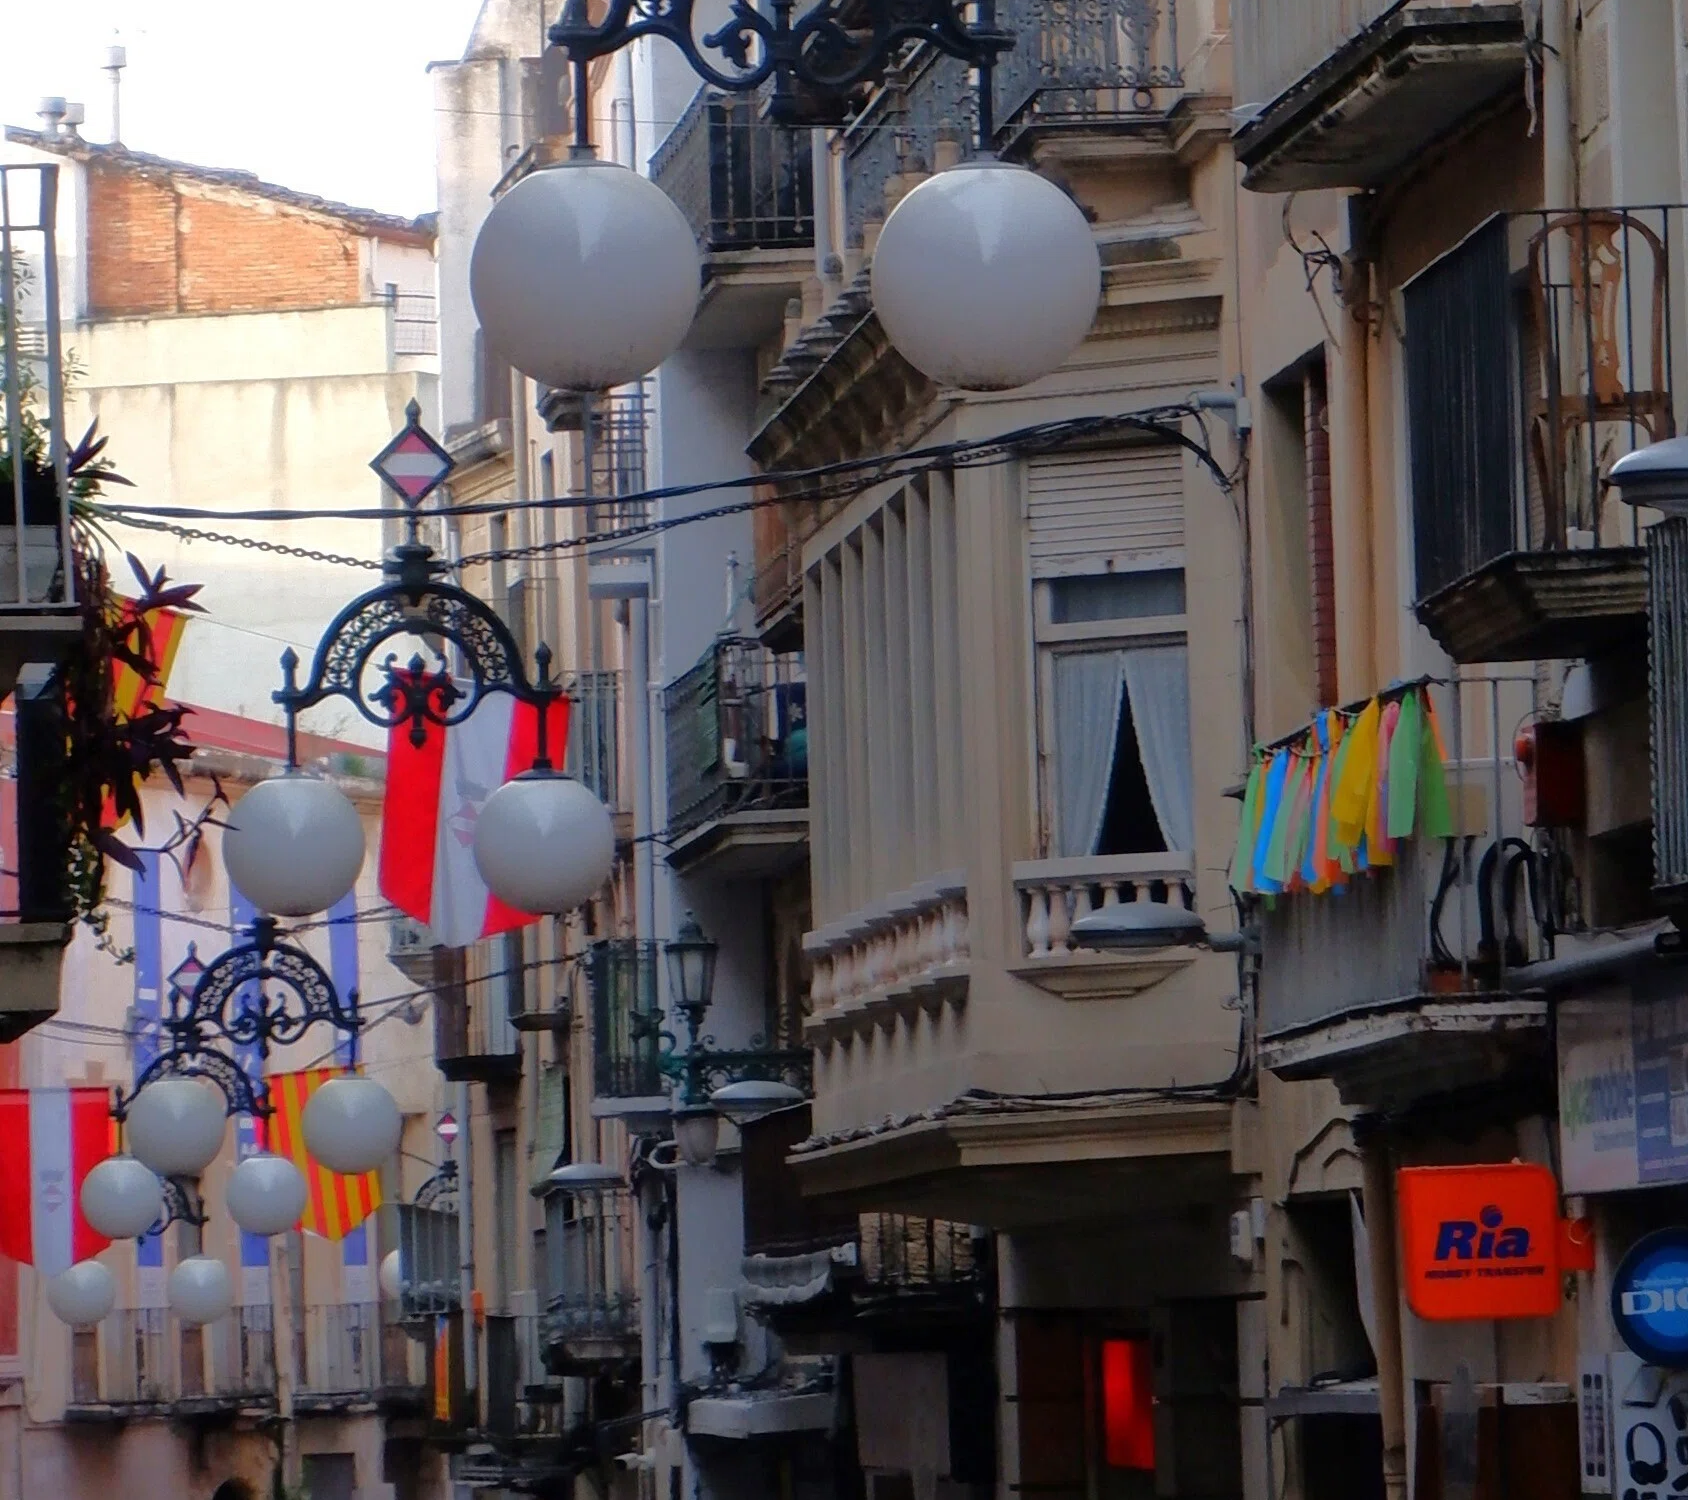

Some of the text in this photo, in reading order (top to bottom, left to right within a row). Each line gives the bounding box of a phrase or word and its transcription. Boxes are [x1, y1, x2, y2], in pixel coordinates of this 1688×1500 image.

[1434, 1204, 1531, 1261] Ria
[1425, 1266, 1546, 1280] MONEY TRANSFER
